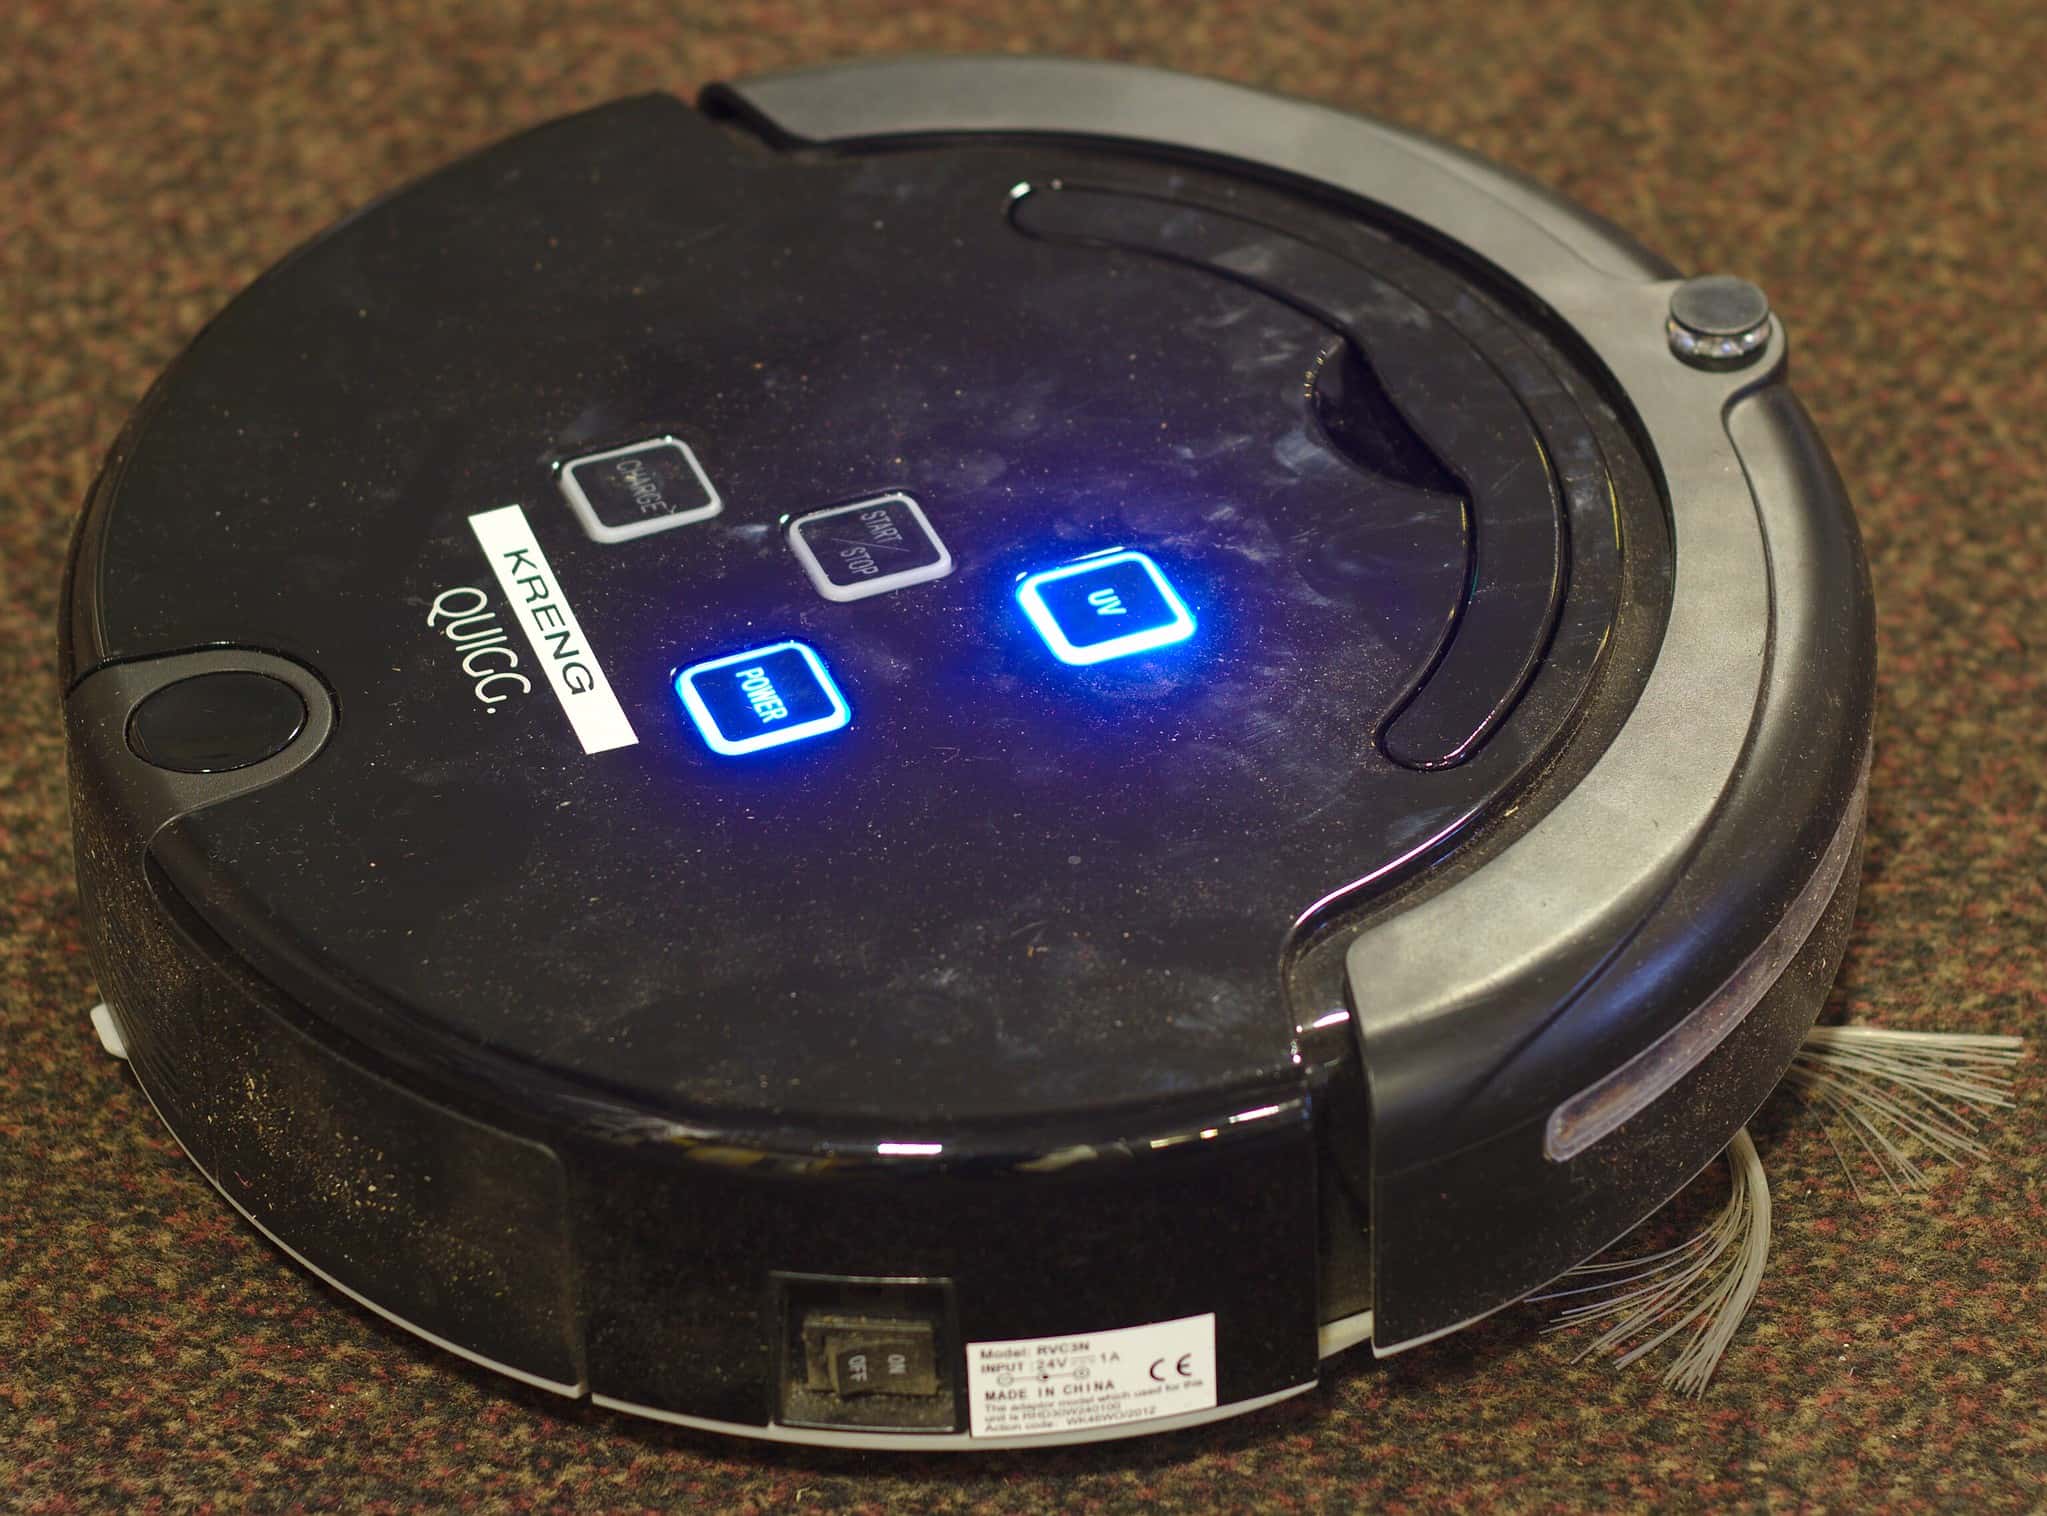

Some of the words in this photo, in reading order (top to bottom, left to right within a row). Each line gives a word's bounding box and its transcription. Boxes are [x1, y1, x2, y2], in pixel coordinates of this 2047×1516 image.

[861, 510, 903, 543] START
[841, 546, 879, 574] STOP
[1088, 588, 1127, 616] UV
[503, 548, 595, 695] KRENG
[736, 667, 788, 723] POWER
[1037, 1342, 1090, 1355] RVC3N
[888, 1354, 906, 1374] ON
[980, 1361, 1024, 1373] INPUT
[1149, 1353, 1193, 1382] CE
[984, 1388, 1027, 1401] MADE
[1037, 1385, 1055, 1398] IN
[1062, 1379, 1116, 1396] CHINA
